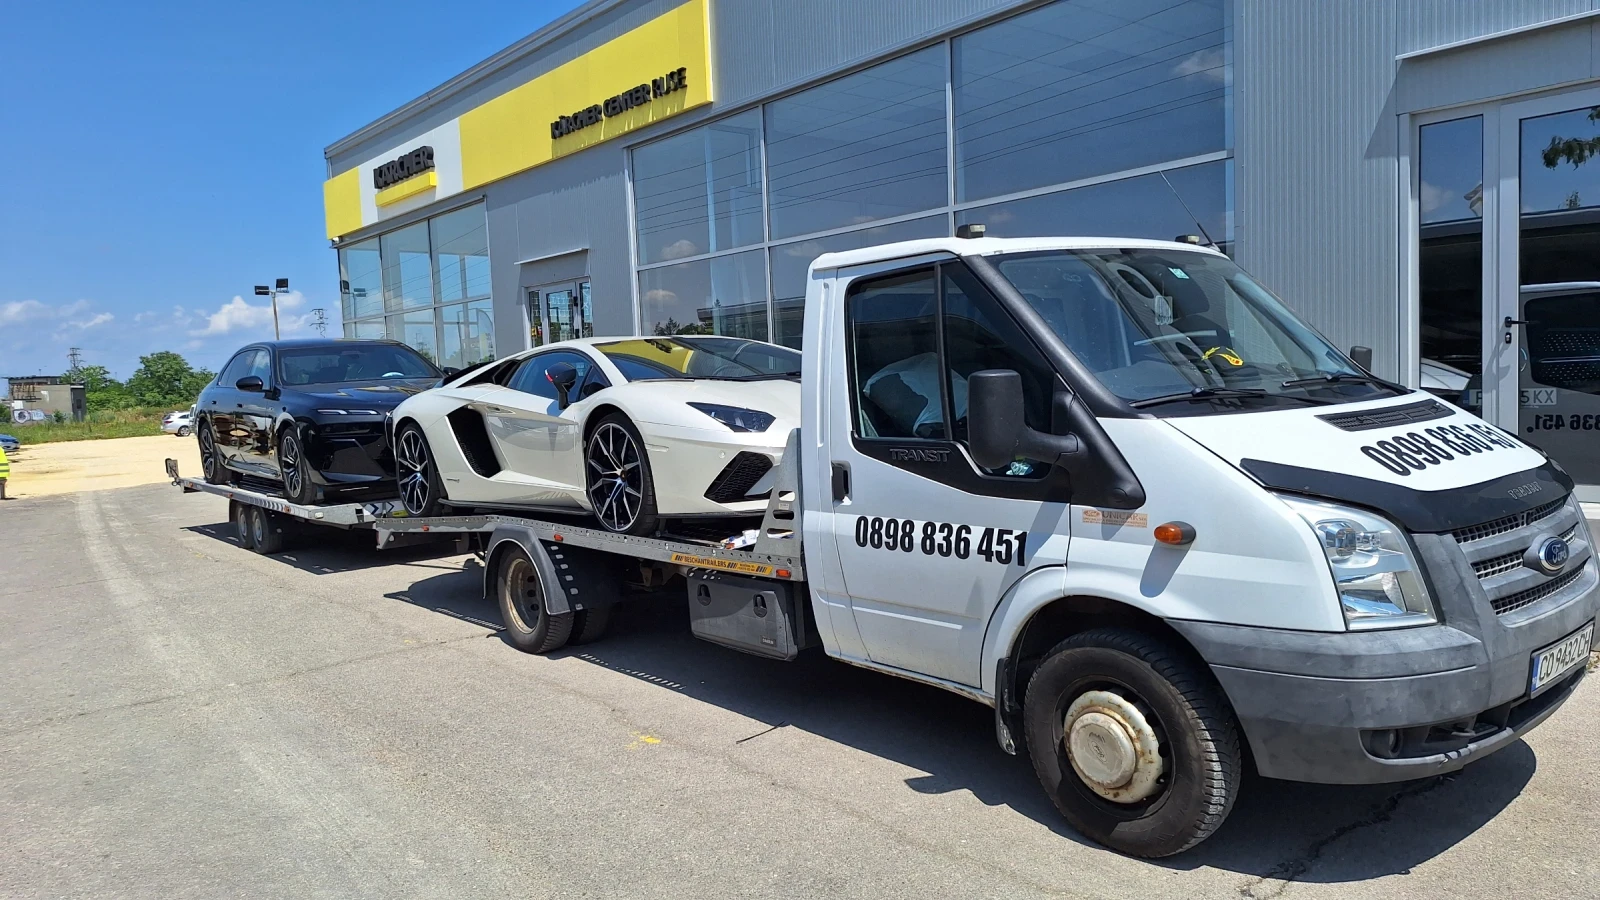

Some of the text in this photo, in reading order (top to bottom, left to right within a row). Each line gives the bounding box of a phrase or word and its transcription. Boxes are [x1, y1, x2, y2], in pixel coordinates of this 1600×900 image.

[603, 84, 652, 117] CENTER
[652, 67, 688, 98] RUSE
[889, 449, 950, 462] TRANSIT
[1360, 424, 1523, 476] 0898 836 451
[855, 515, 1028, 567] 0898 836 451
[1551, 543, 1567, 563] Ford
